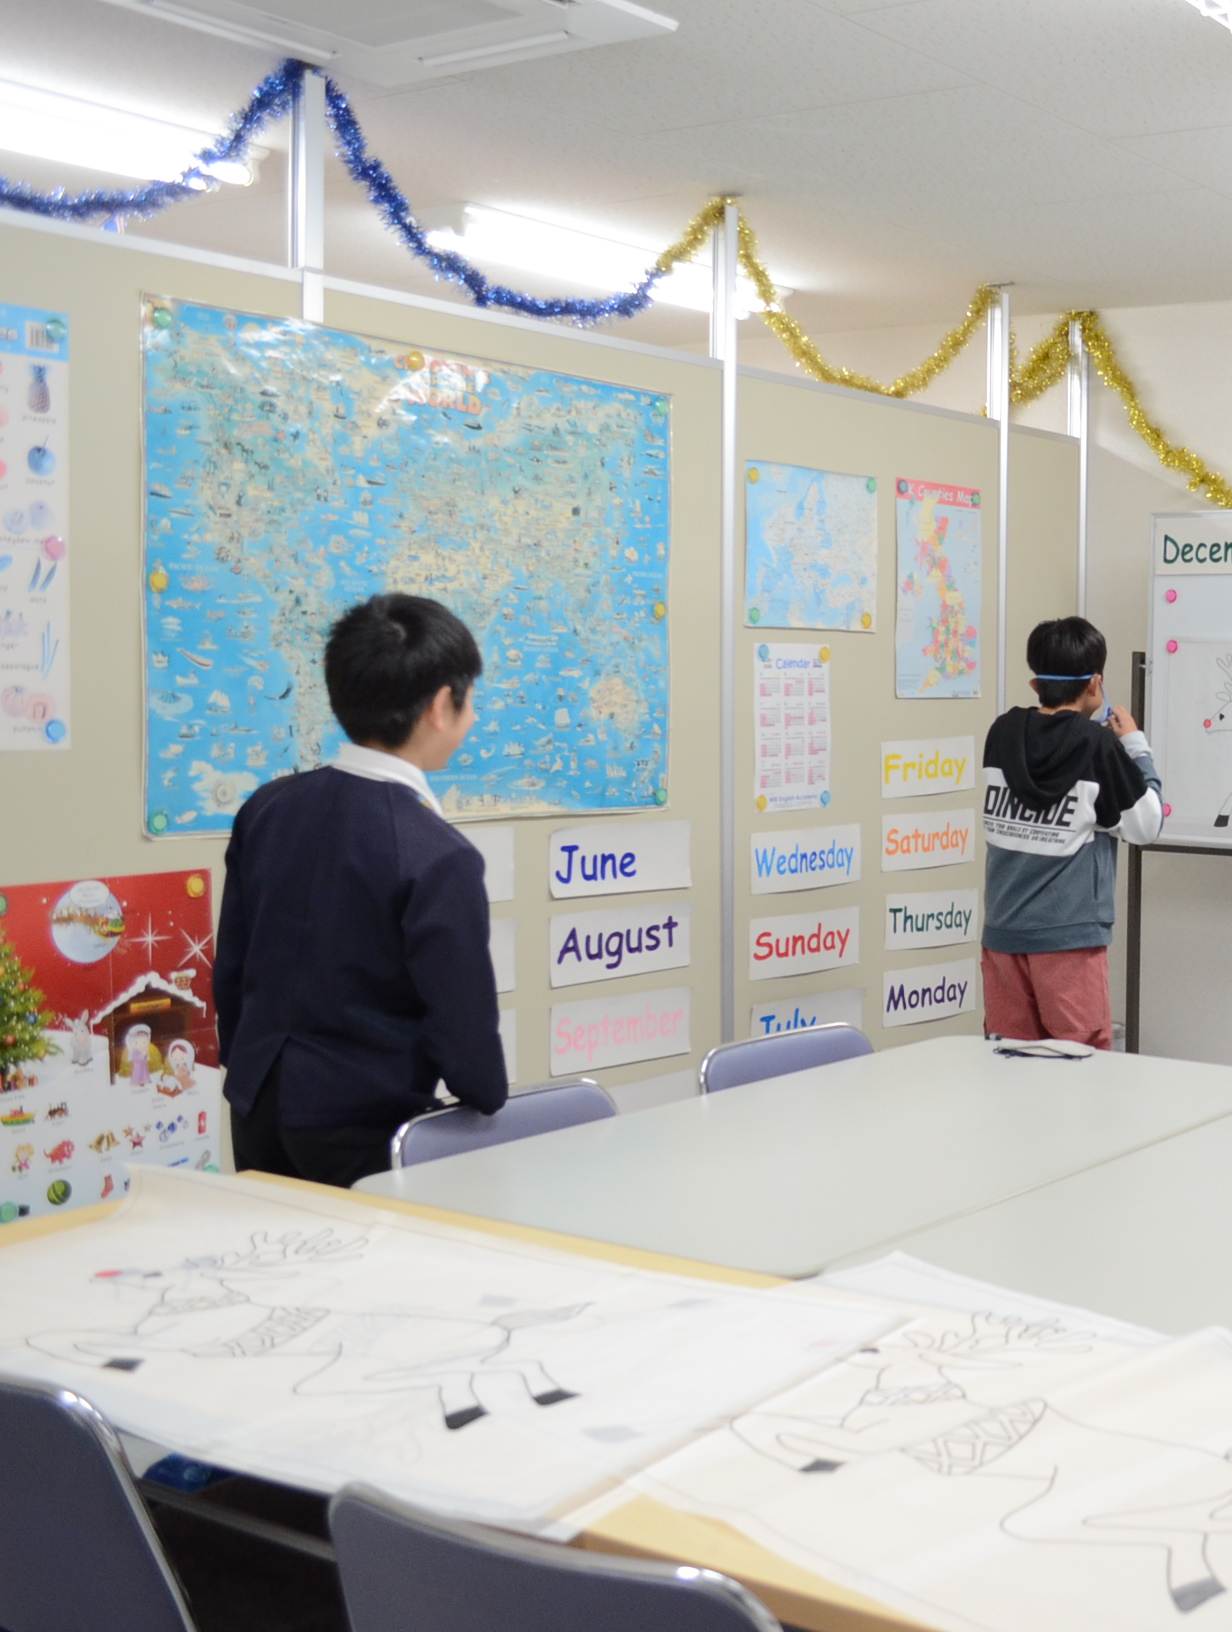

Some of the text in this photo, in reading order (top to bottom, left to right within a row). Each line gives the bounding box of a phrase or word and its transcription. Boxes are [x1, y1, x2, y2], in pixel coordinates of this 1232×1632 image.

[882, 751, 969, 785] Friday
[884, 822, 969, 856] Saturday
[555, 844, 637, 884] June
[755, 840, 854, 876] Wednesday
[889, 902, 972, 936] Thursday
[556, 915, 678, 969] August
[753, 923, 850, 961] Sunday
[886, 976, 968, 1013] Monday
[555, 1003, 685, 1062] September
